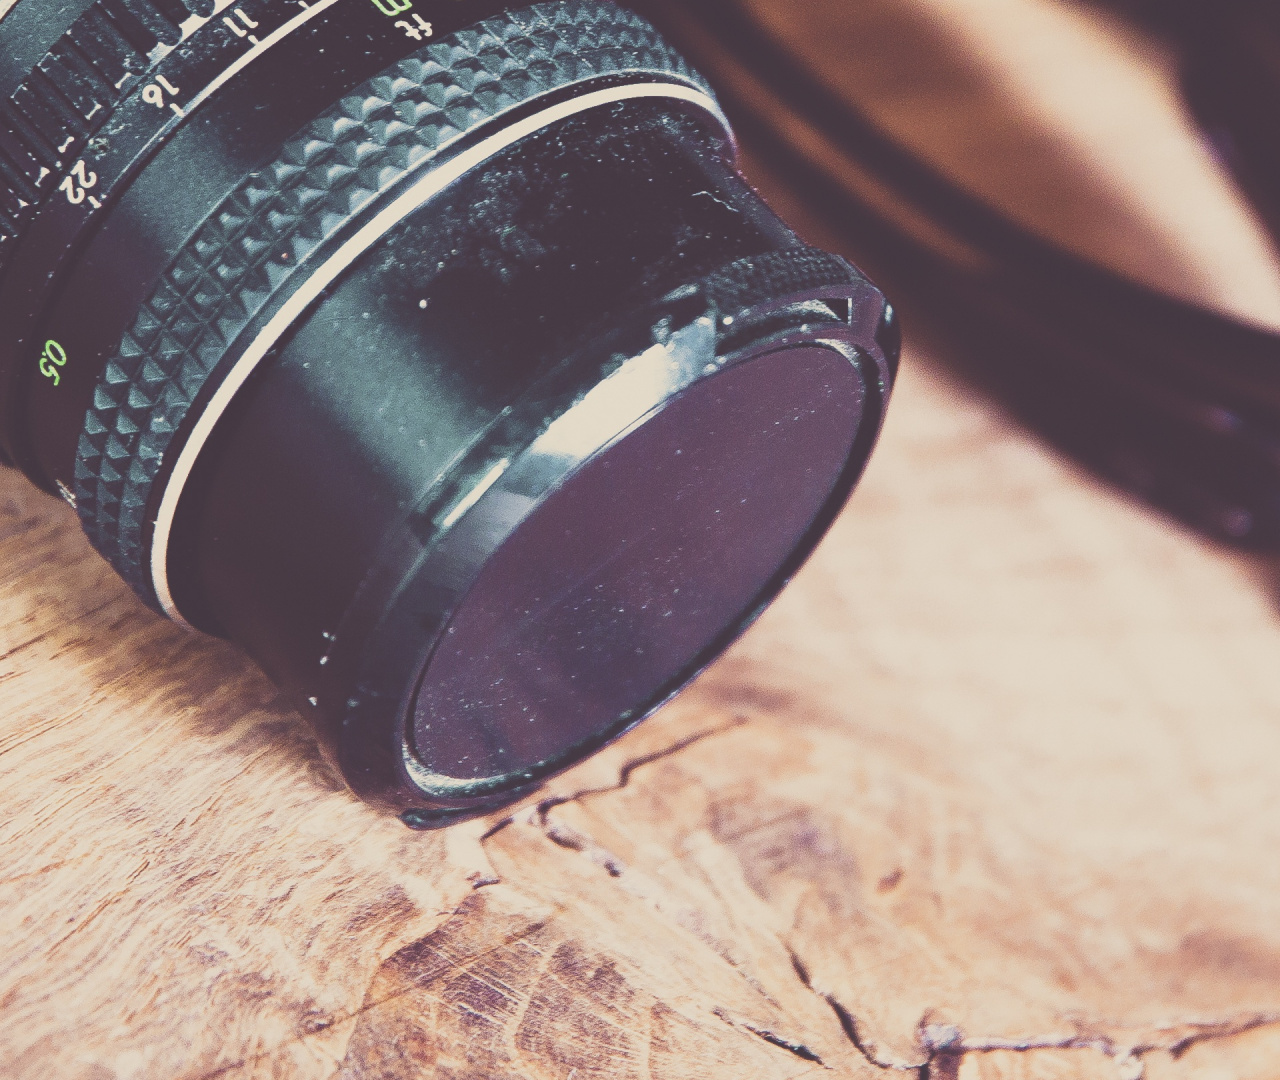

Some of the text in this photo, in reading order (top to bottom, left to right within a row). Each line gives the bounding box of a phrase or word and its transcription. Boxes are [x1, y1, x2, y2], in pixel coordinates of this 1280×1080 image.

[222, 8, 258, 37] 11
[394, 13, 433, 41] ft
[142, 74, 181, 107] 16
[59, 159, 97, 204] 22
